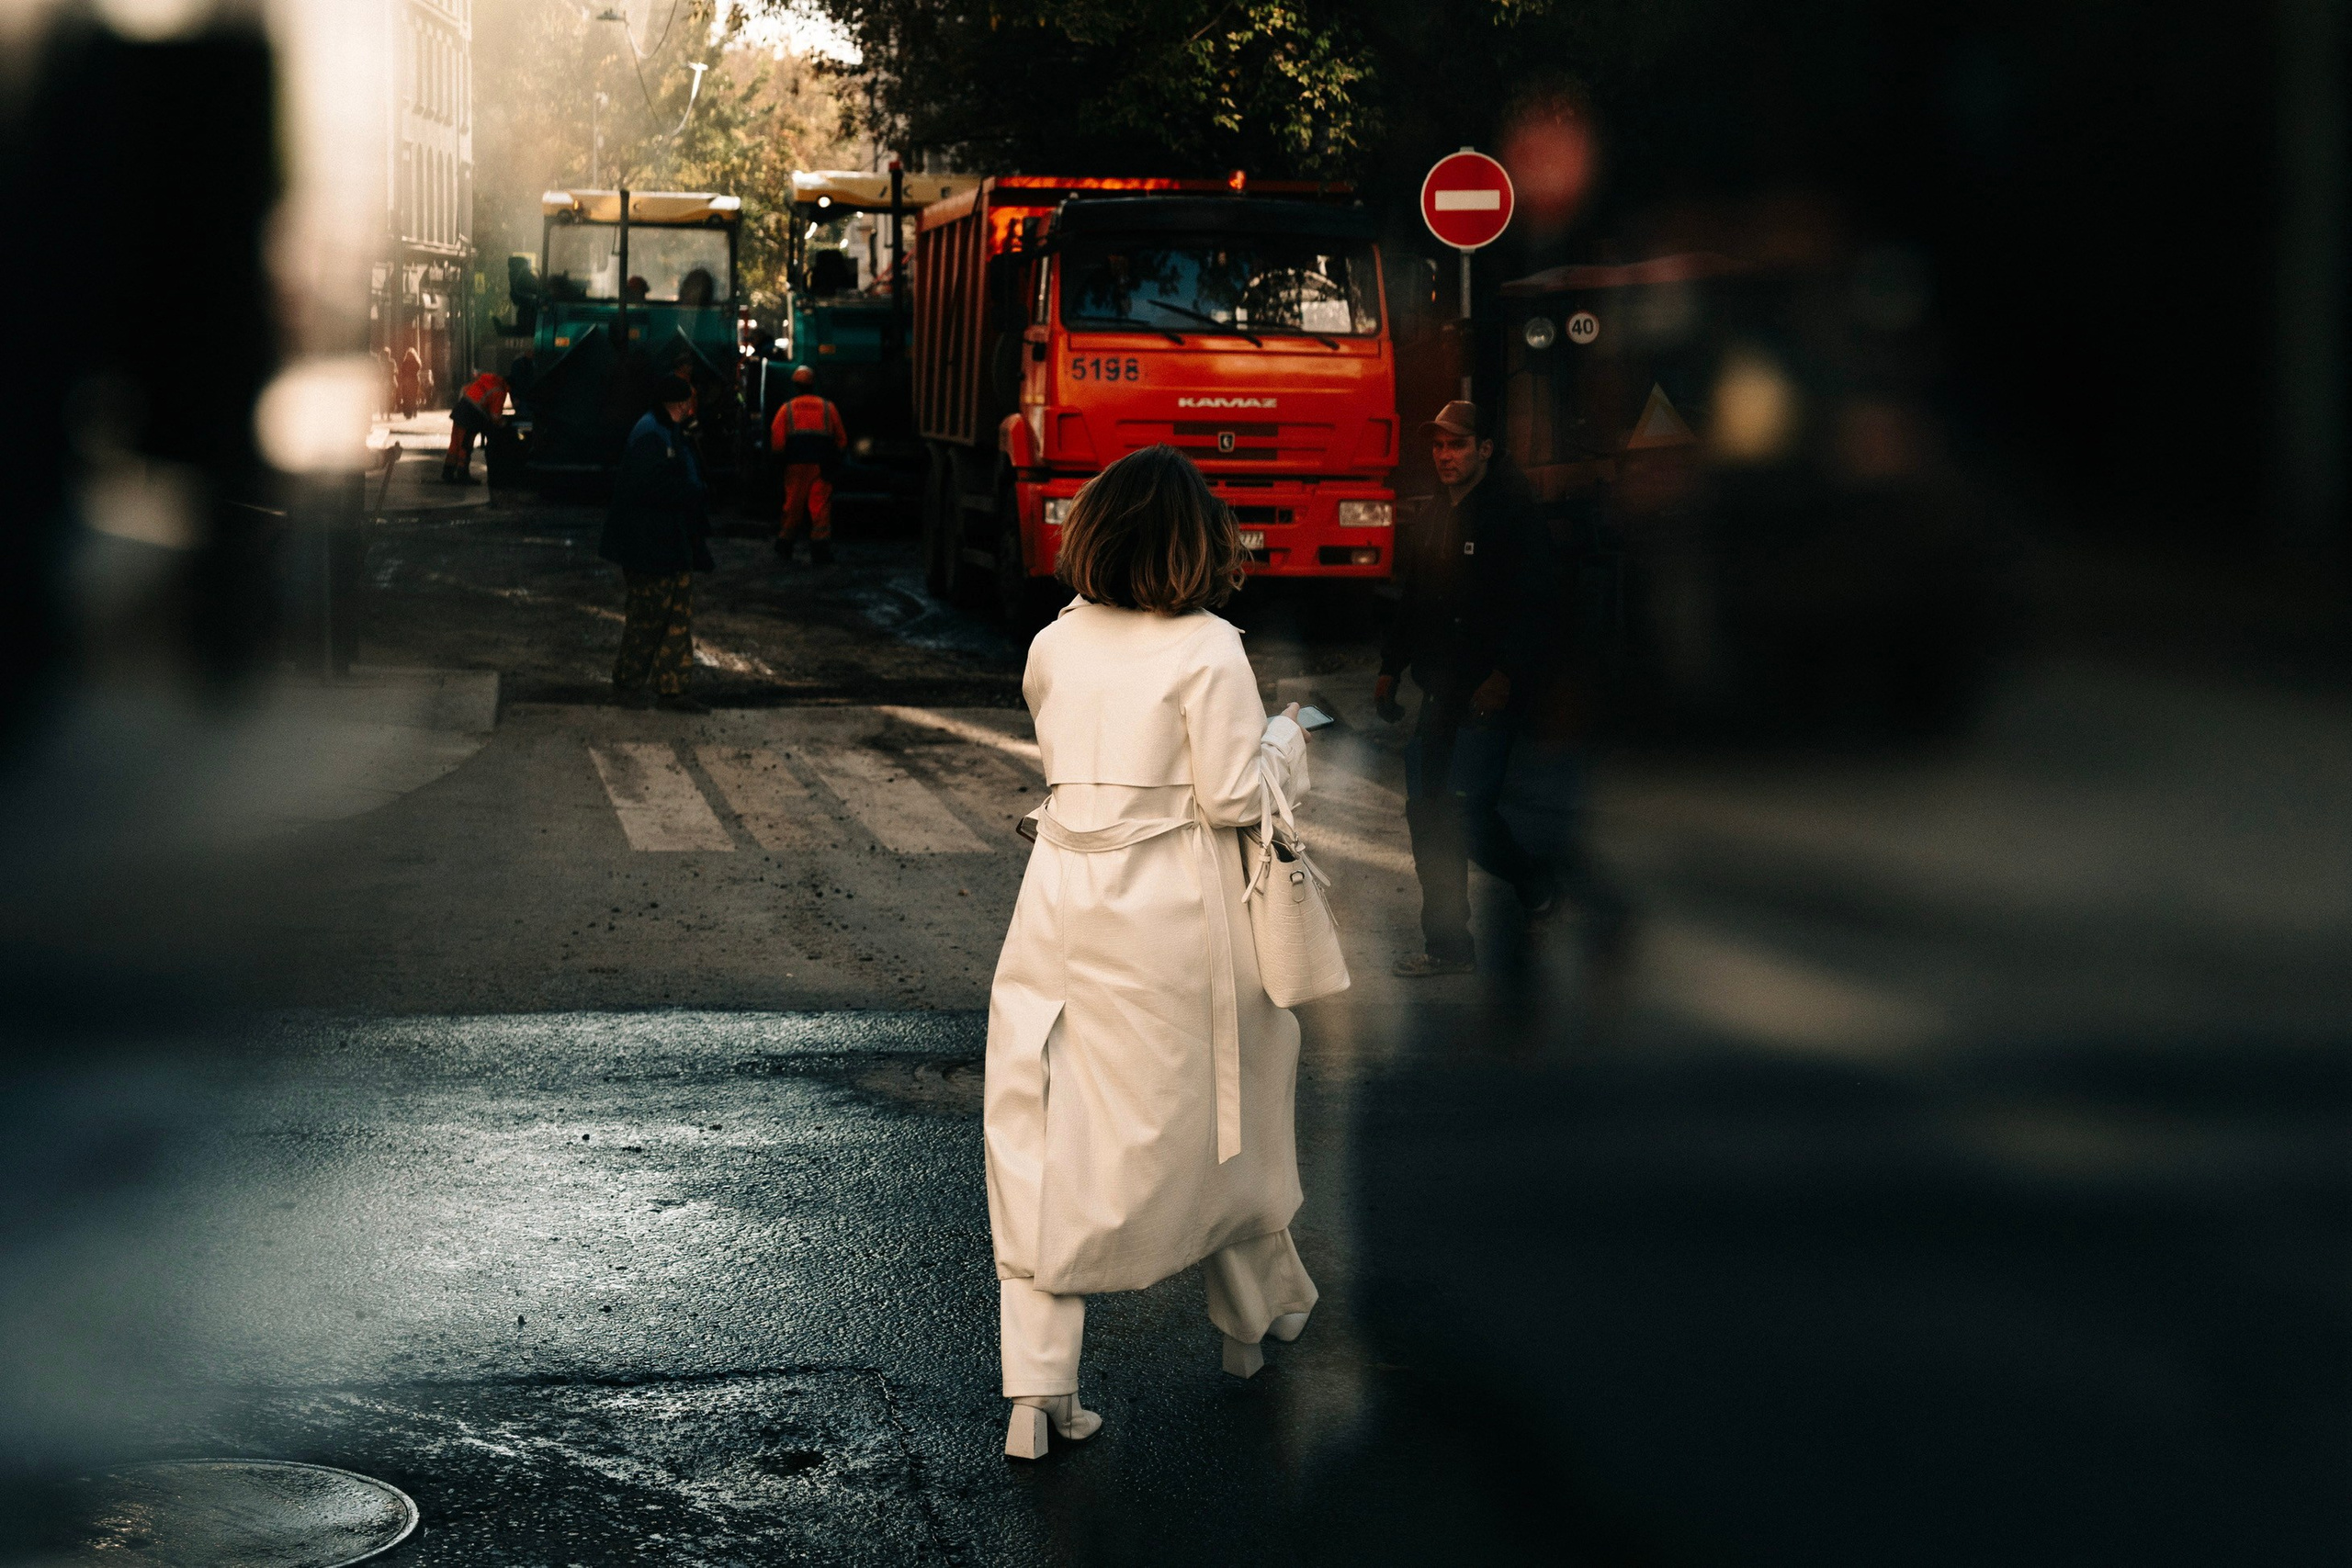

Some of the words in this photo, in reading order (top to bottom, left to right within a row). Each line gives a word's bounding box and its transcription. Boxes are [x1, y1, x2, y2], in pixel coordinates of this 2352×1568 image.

[1572, 319, 1593, 334] 40
[1071, 357, 1139, 381] 5198
[1178, 397, 1277, 408] KAMAZ
